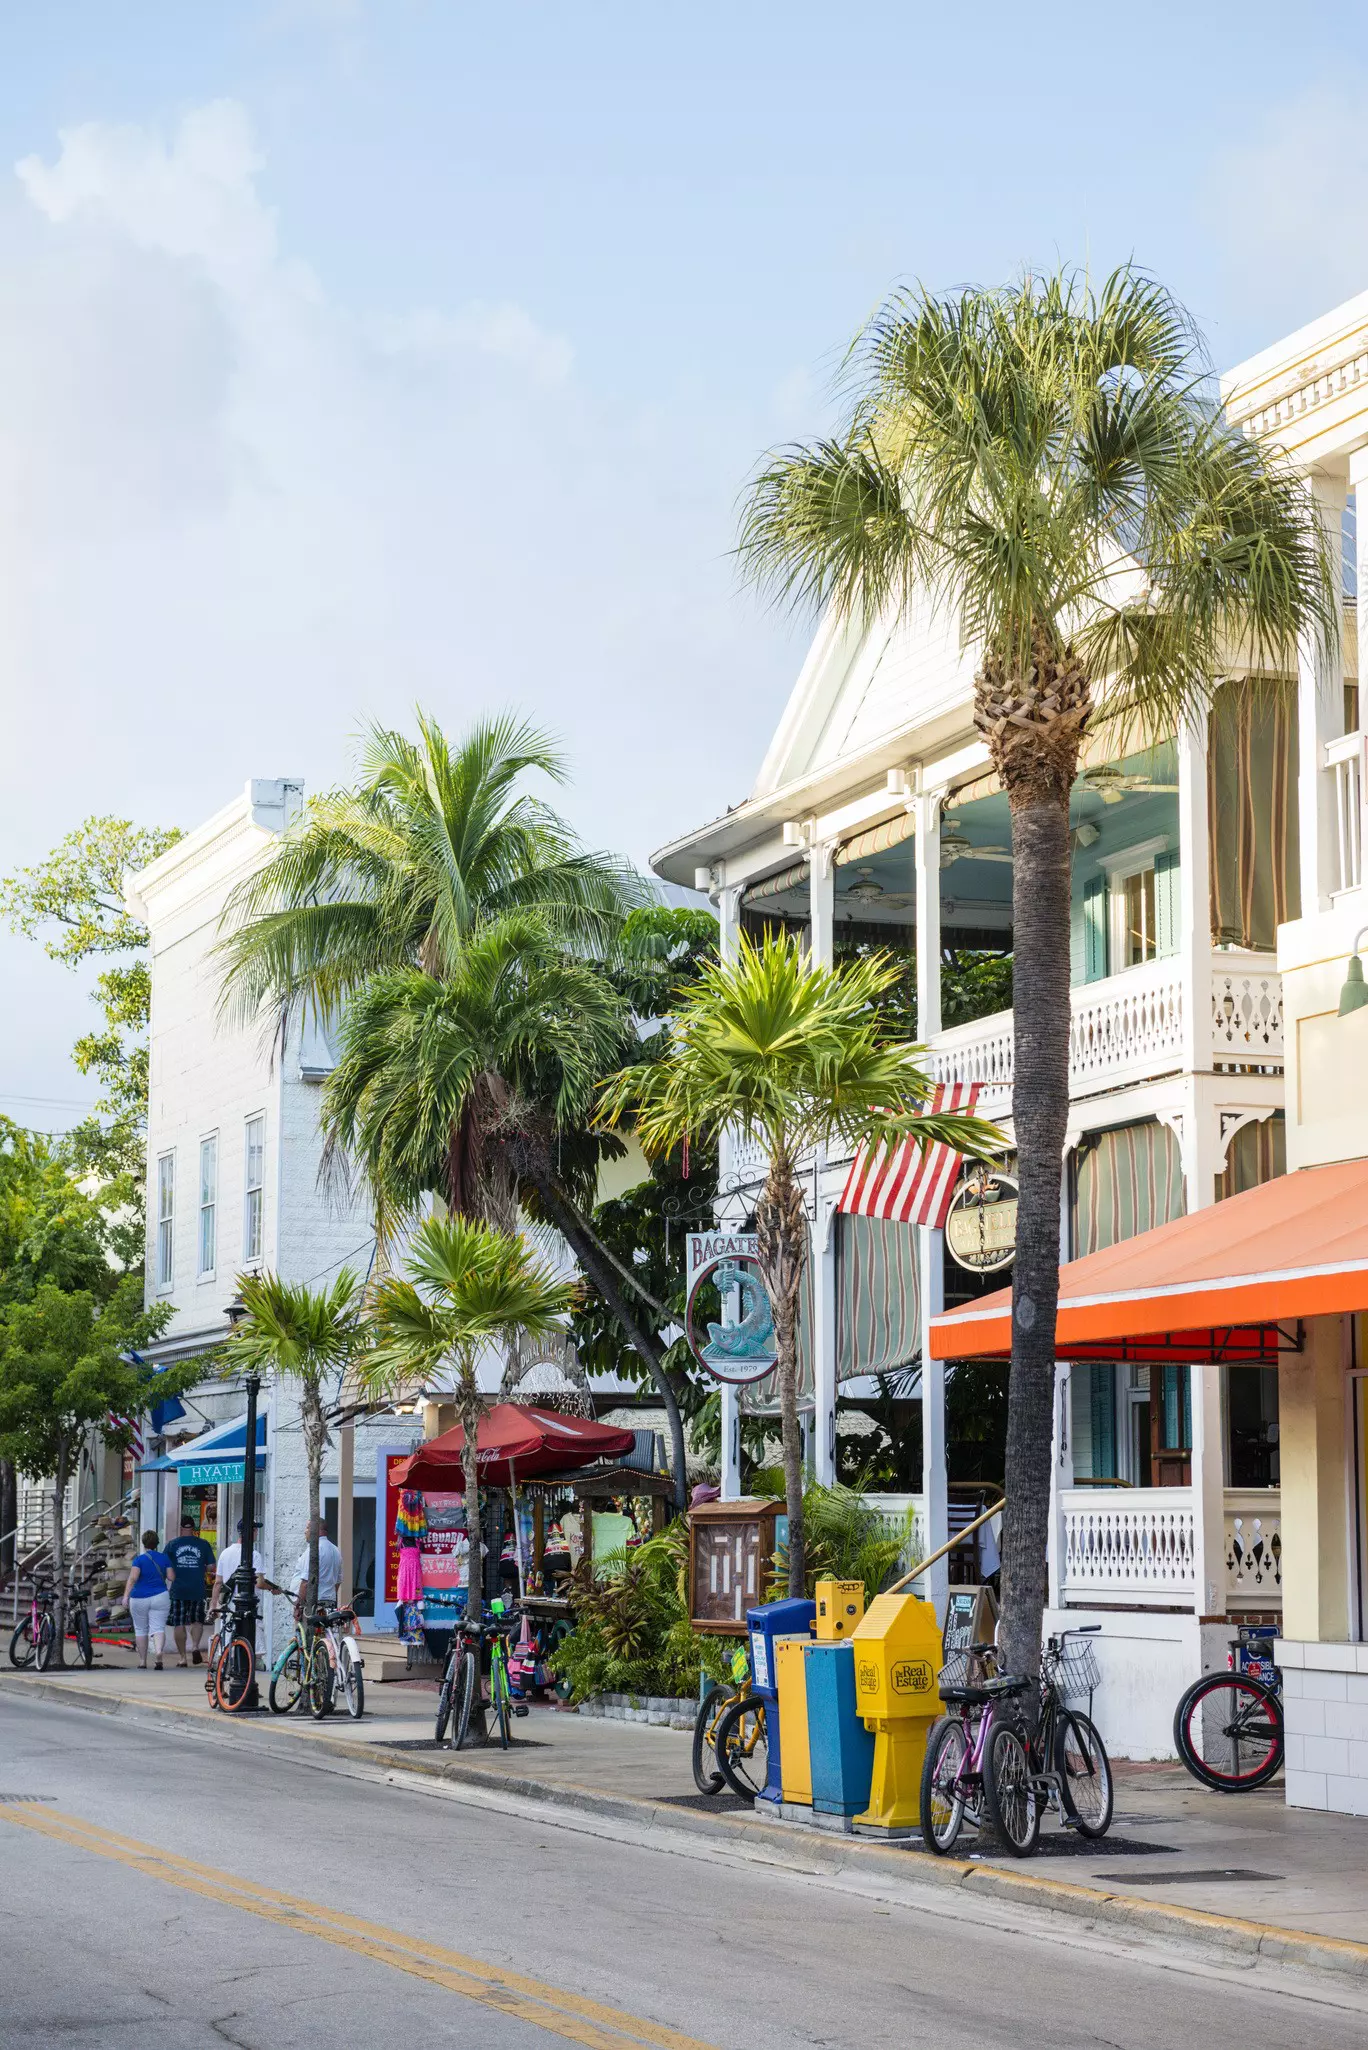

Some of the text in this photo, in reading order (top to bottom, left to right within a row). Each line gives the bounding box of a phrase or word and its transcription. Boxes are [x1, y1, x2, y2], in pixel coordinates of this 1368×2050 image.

[740, 1364, 758, 1373] 1979
[191, 1464, 241, 1478] HYATT
[902, 1664, 926, 1677] Real
[895, 1676, 928, 1687] Estate
